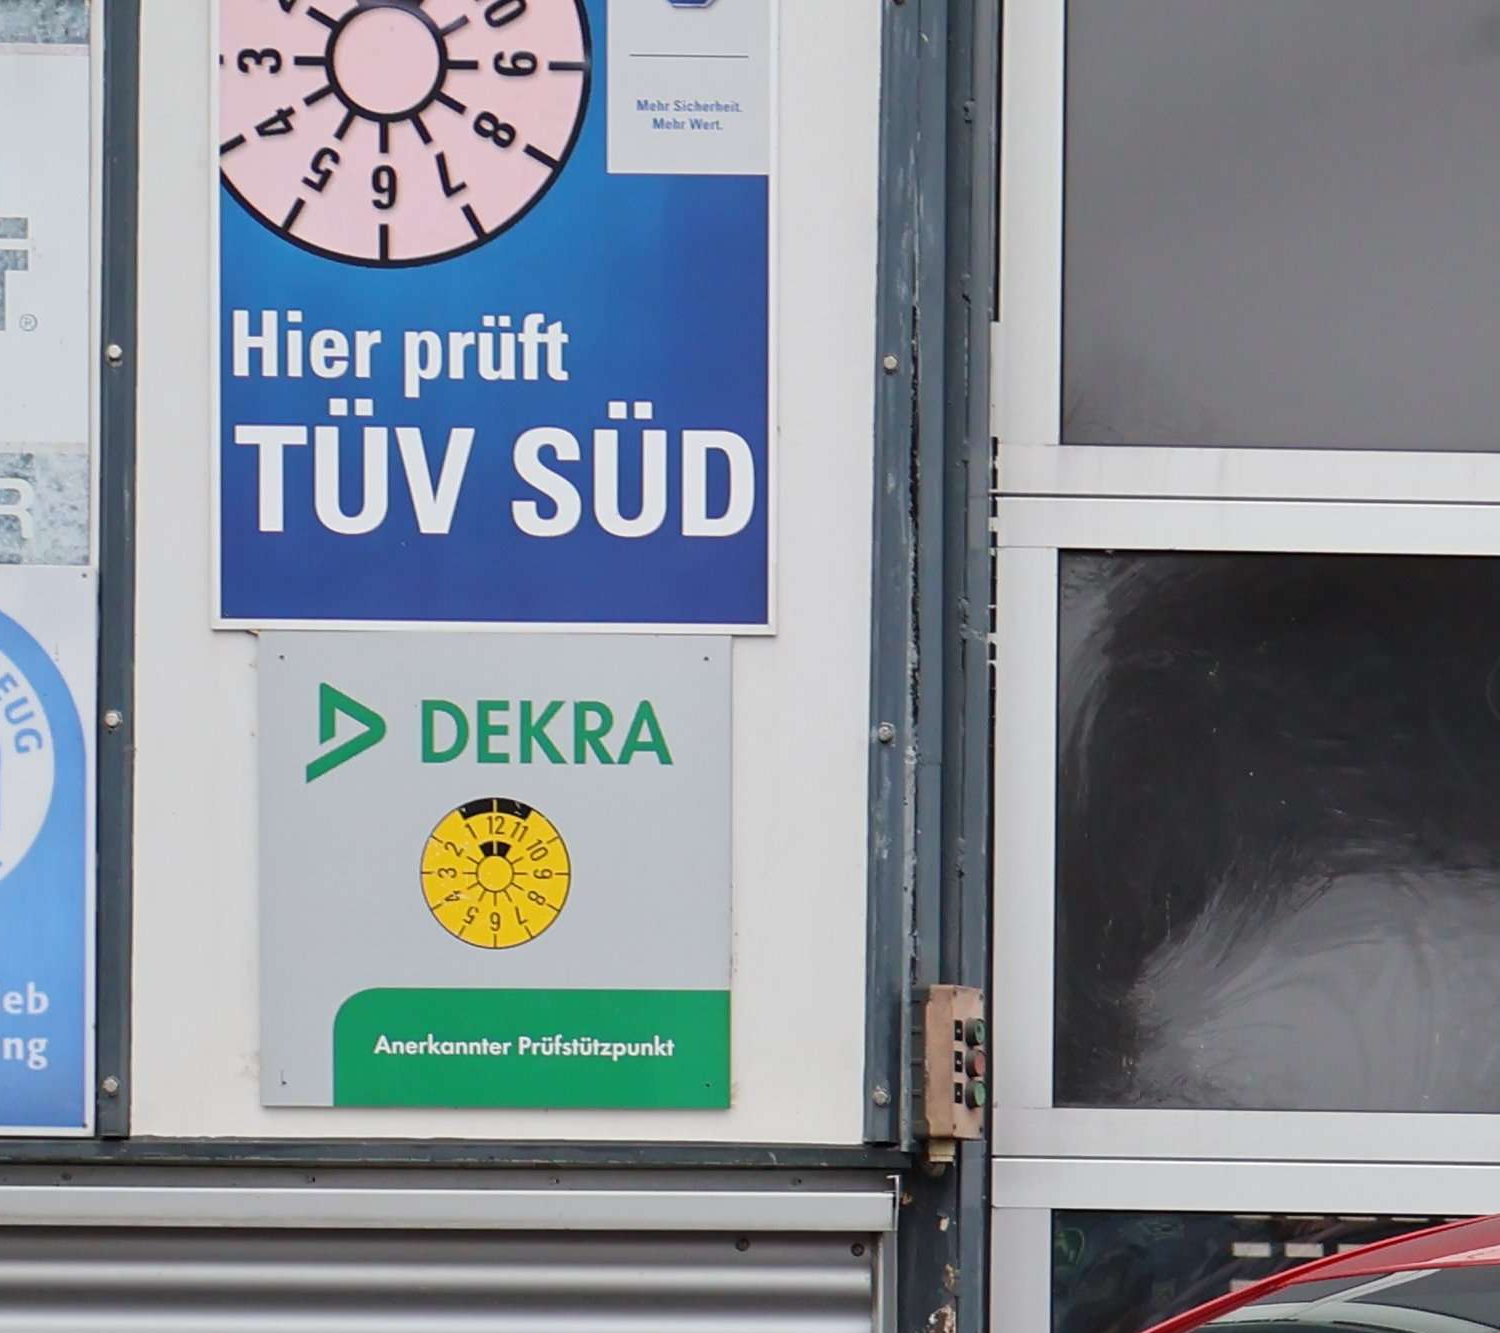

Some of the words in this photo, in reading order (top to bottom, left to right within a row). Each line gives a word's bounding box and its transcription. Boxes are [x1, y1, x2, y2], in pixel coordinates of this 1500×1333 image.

[237, 48, 283, 74] 3
[493, 51, 538, 76] 9
[636, 99, 670, 111] Mehr
[673, 99, 743, 112] Sicherheit.
[255, 106, 295, 138] 4
[472, 110, 516, 148] 8
[652, 118, 686, 129] Mehr
[689, 118, 724, 130] Wert.
[302, 146, 340, 192] 5
[434, 152, 467, 198] 7
[371, 165, 397, 210] 6
[232, 309, 382, 378] Hier
[404, 313, 569, 398] prüft
[234, 398, 476, 534] TÜV
[511, 401, 756, 538] SÜD
[420, 699, 674, 765] DEKRA
[464, 823, 478, 840] 1
[486, 815, 505, 835] 12
[510, 821, 529, 842] 11
[444, 841, 465, 857] 2
[526, 838, 549, 862] 10
[437, 867, 458, 879] 3
[533, 868, 553, 880] 9
[444, 890, 462, 902] 4
[527, 890, 547, 906] 8
[462, 906, 480, 925] 5
[490, 911, 501, 932] 6
[515, 905, 528, 925] 7
[374, 1034, 512, 1056] Anerkannter
[518, 1035, 675, 1063] Prüfstützpunkt
